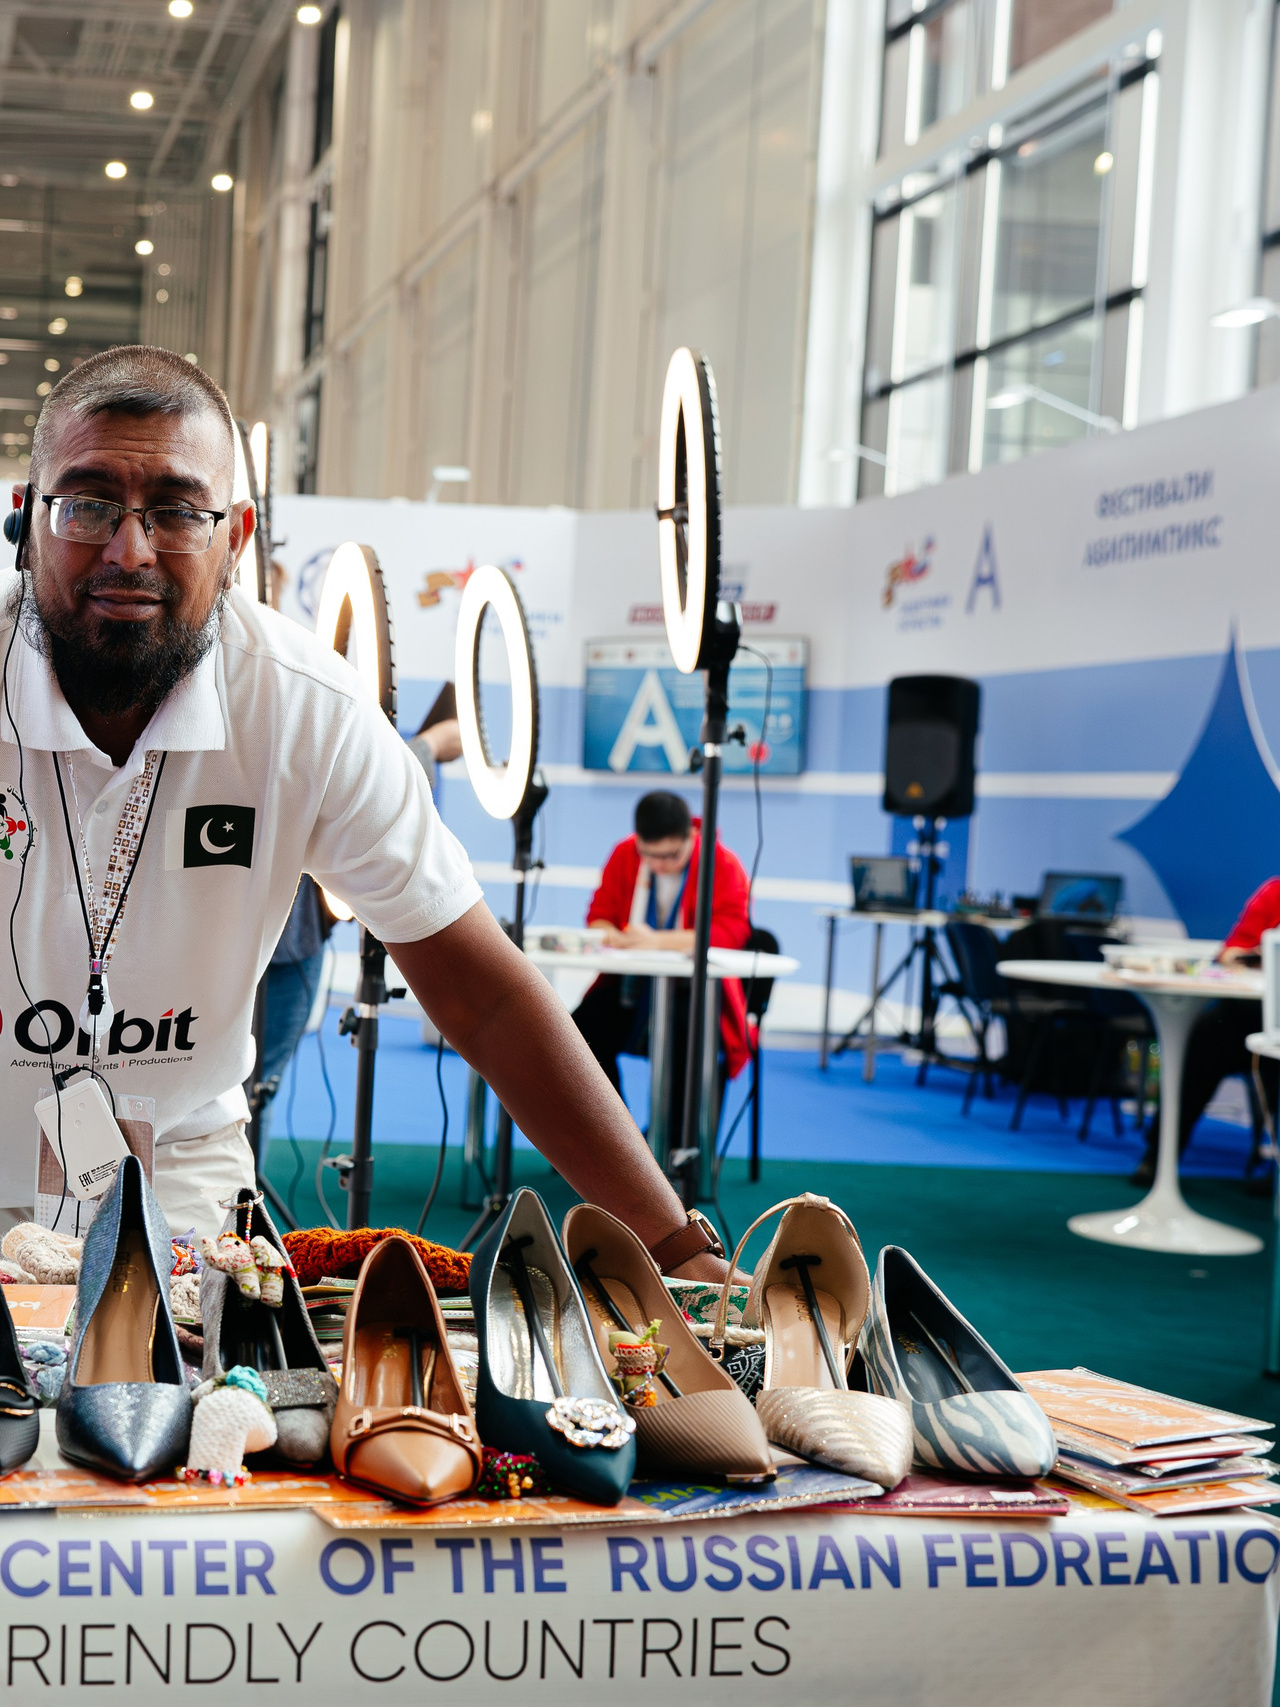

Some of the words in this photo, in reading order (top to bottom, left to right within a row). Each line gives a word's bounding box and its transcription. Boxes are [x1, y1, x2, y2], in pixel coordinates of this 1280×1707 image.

[82, 1061, 119, 1071] Ents
[128, 1055, 193, 1067] Productions
[0, 1540, 276, 1598] CENTER
[319, 1538, 414, 1596] OF
[435, 1537, 568, 1594] THE
[606, 1534, 902, 1593] RUSSIAN
[350, 1615, 791, 1683] COUNTRIES
